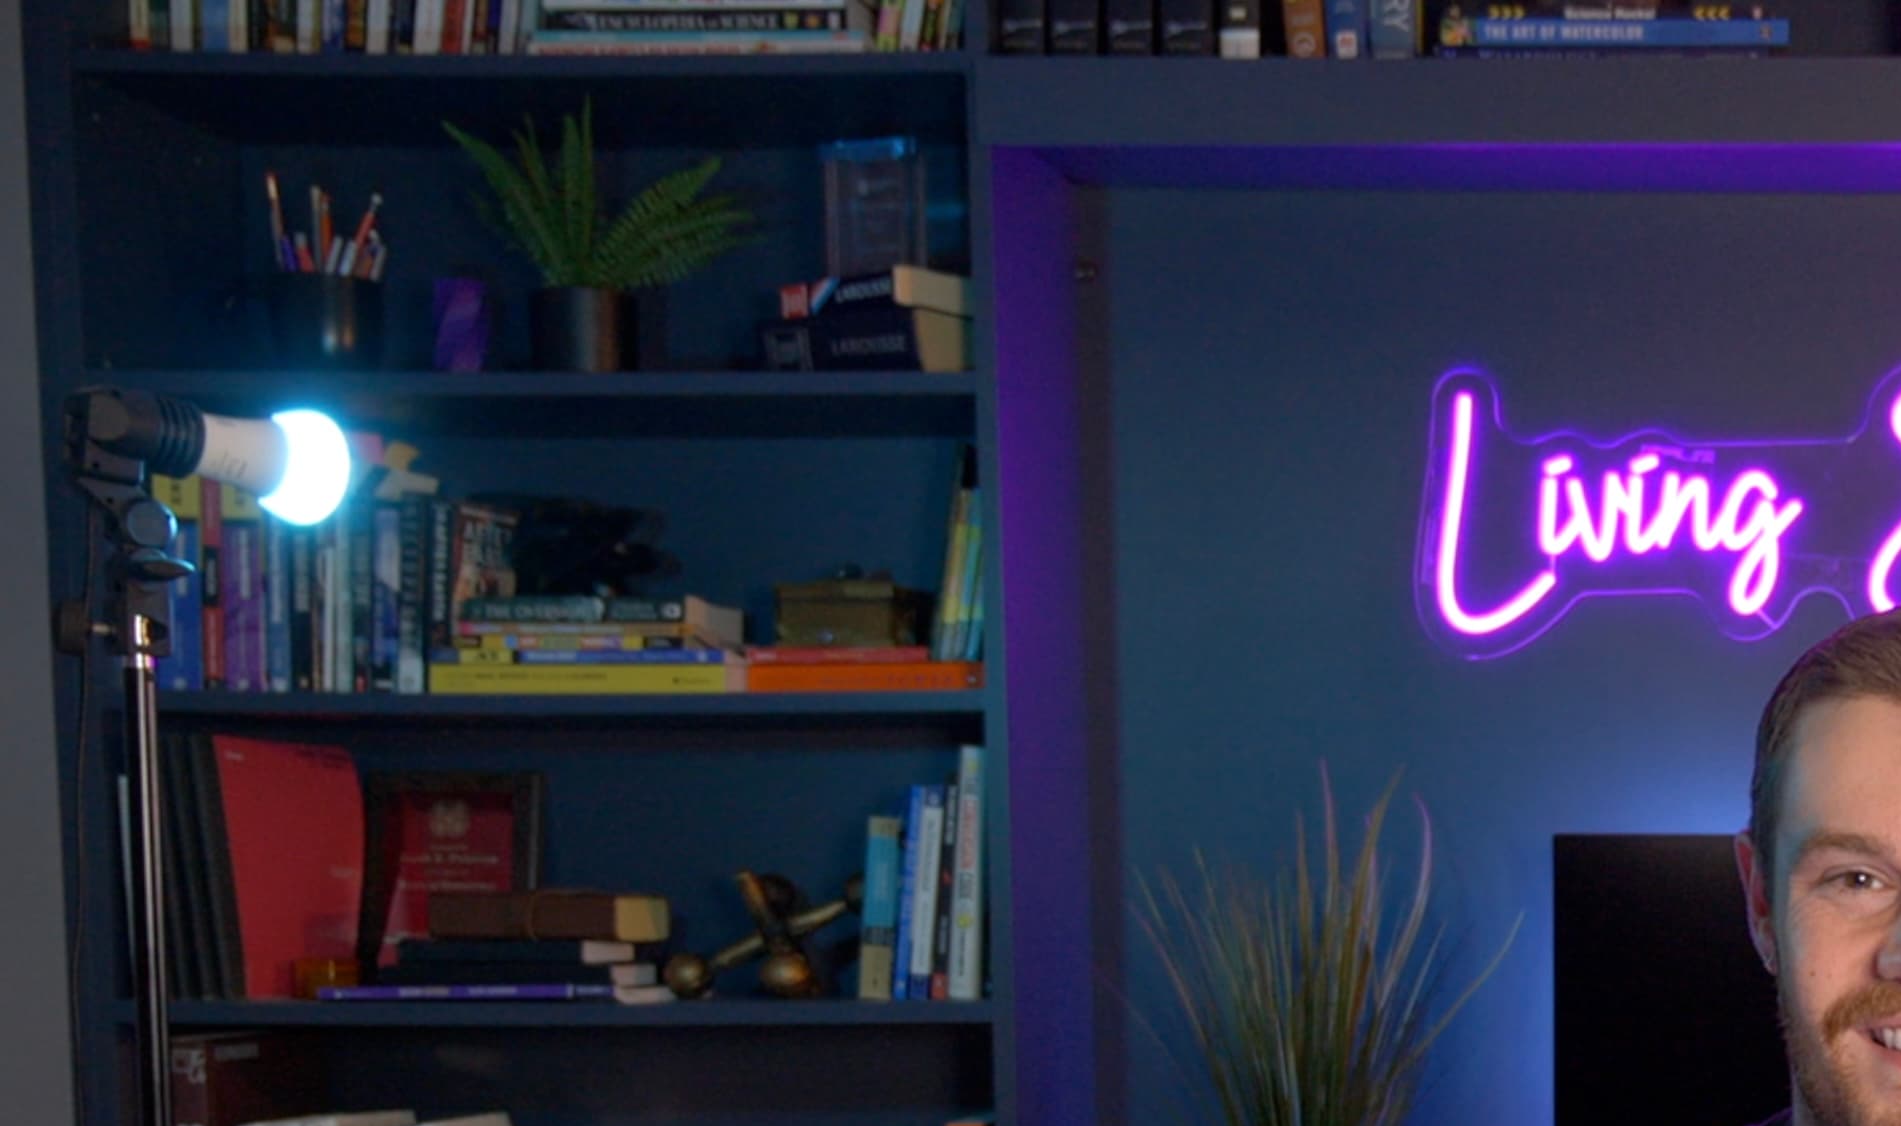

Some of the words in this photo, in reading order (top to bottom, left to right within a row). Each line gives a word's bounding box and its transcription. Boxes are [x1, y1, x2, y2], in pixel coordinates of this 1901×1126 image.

[1484, 24, 1508, 40] THE
[1511, 24, 1536, 40] ART
[1539, 24, 1555, 40] OF
[1560, 24, 1644, 40] WATERCOLOR
[1434, 392, 1806, 635] Living
